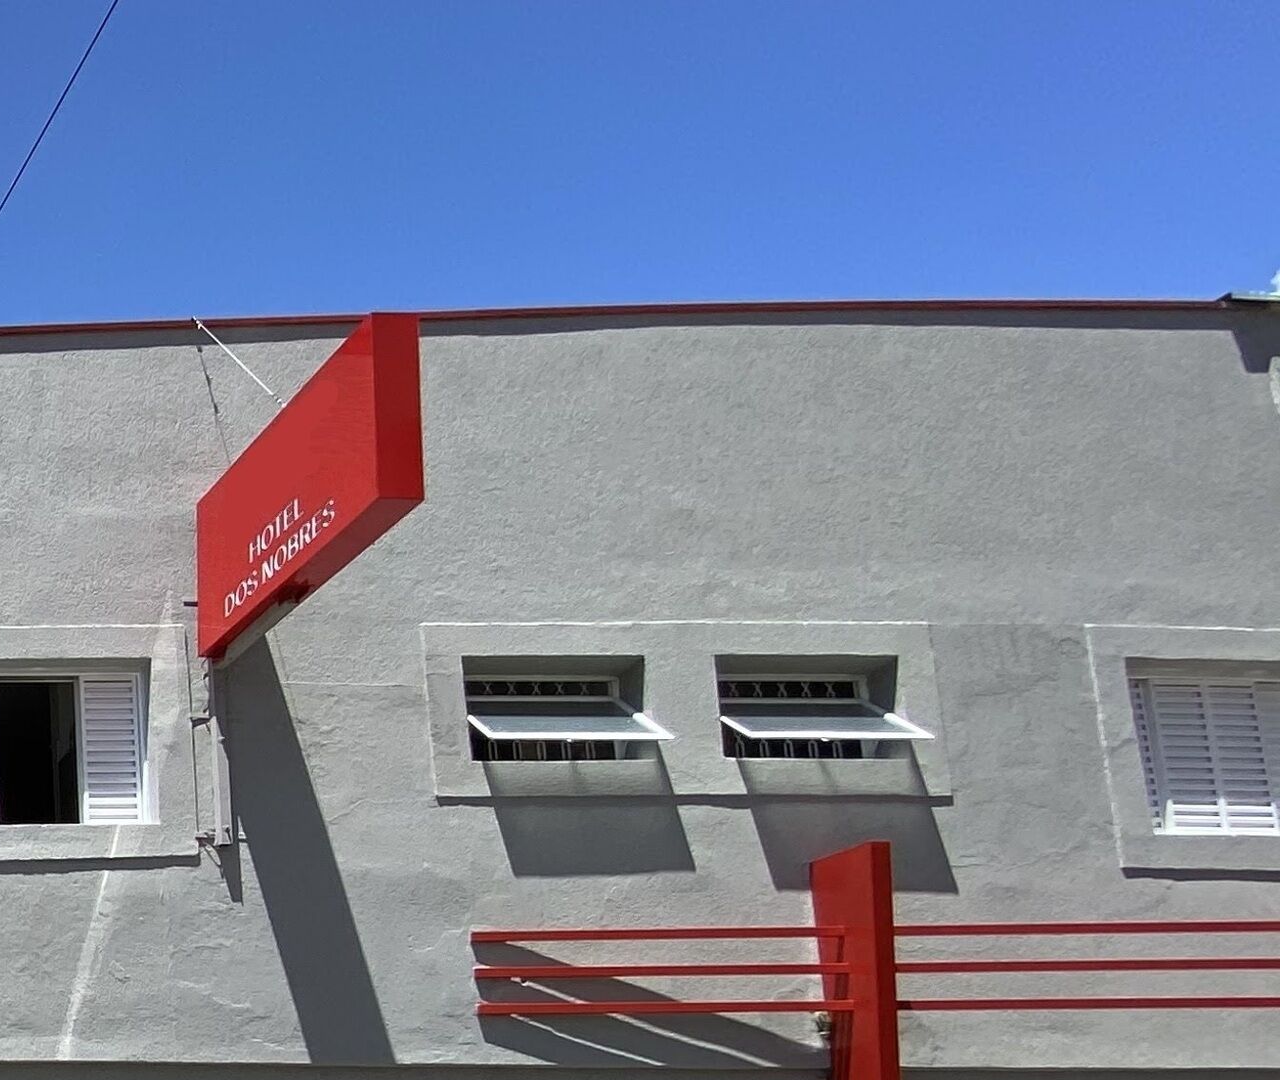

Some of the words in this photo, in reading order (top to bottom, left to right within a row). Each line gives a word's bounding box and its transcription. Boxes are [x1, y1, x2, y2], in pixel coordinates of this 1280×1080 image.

[224, 570, 258, 618] DOS
[261, 500, 336, 584] NOBRES
[248, 498, 304, 563] HOTEL
